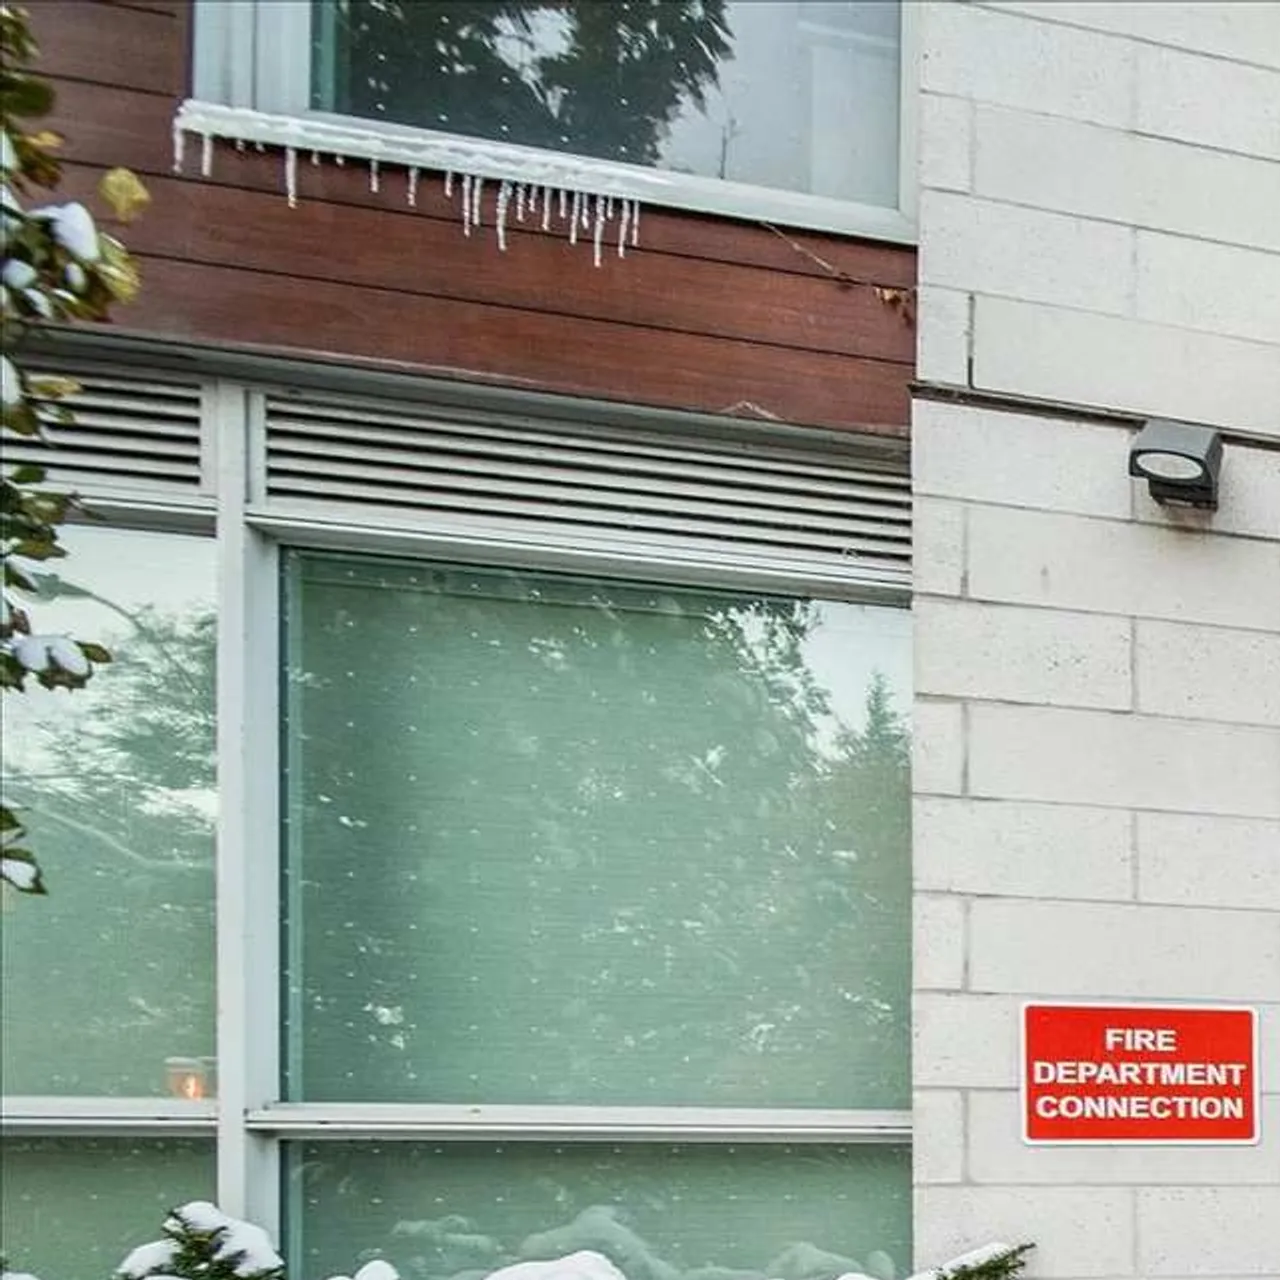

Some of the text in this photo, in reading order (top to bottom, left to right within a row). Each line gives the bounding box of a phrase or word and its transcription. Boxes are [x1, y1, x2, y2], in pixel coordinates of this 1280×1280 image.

[1104, 1027, 1178, 1053] FIRE
[1033, 1060, 1247, 1087] DEPARTMENT
[1035, 1095, 1244, 1120] CONNECTION
